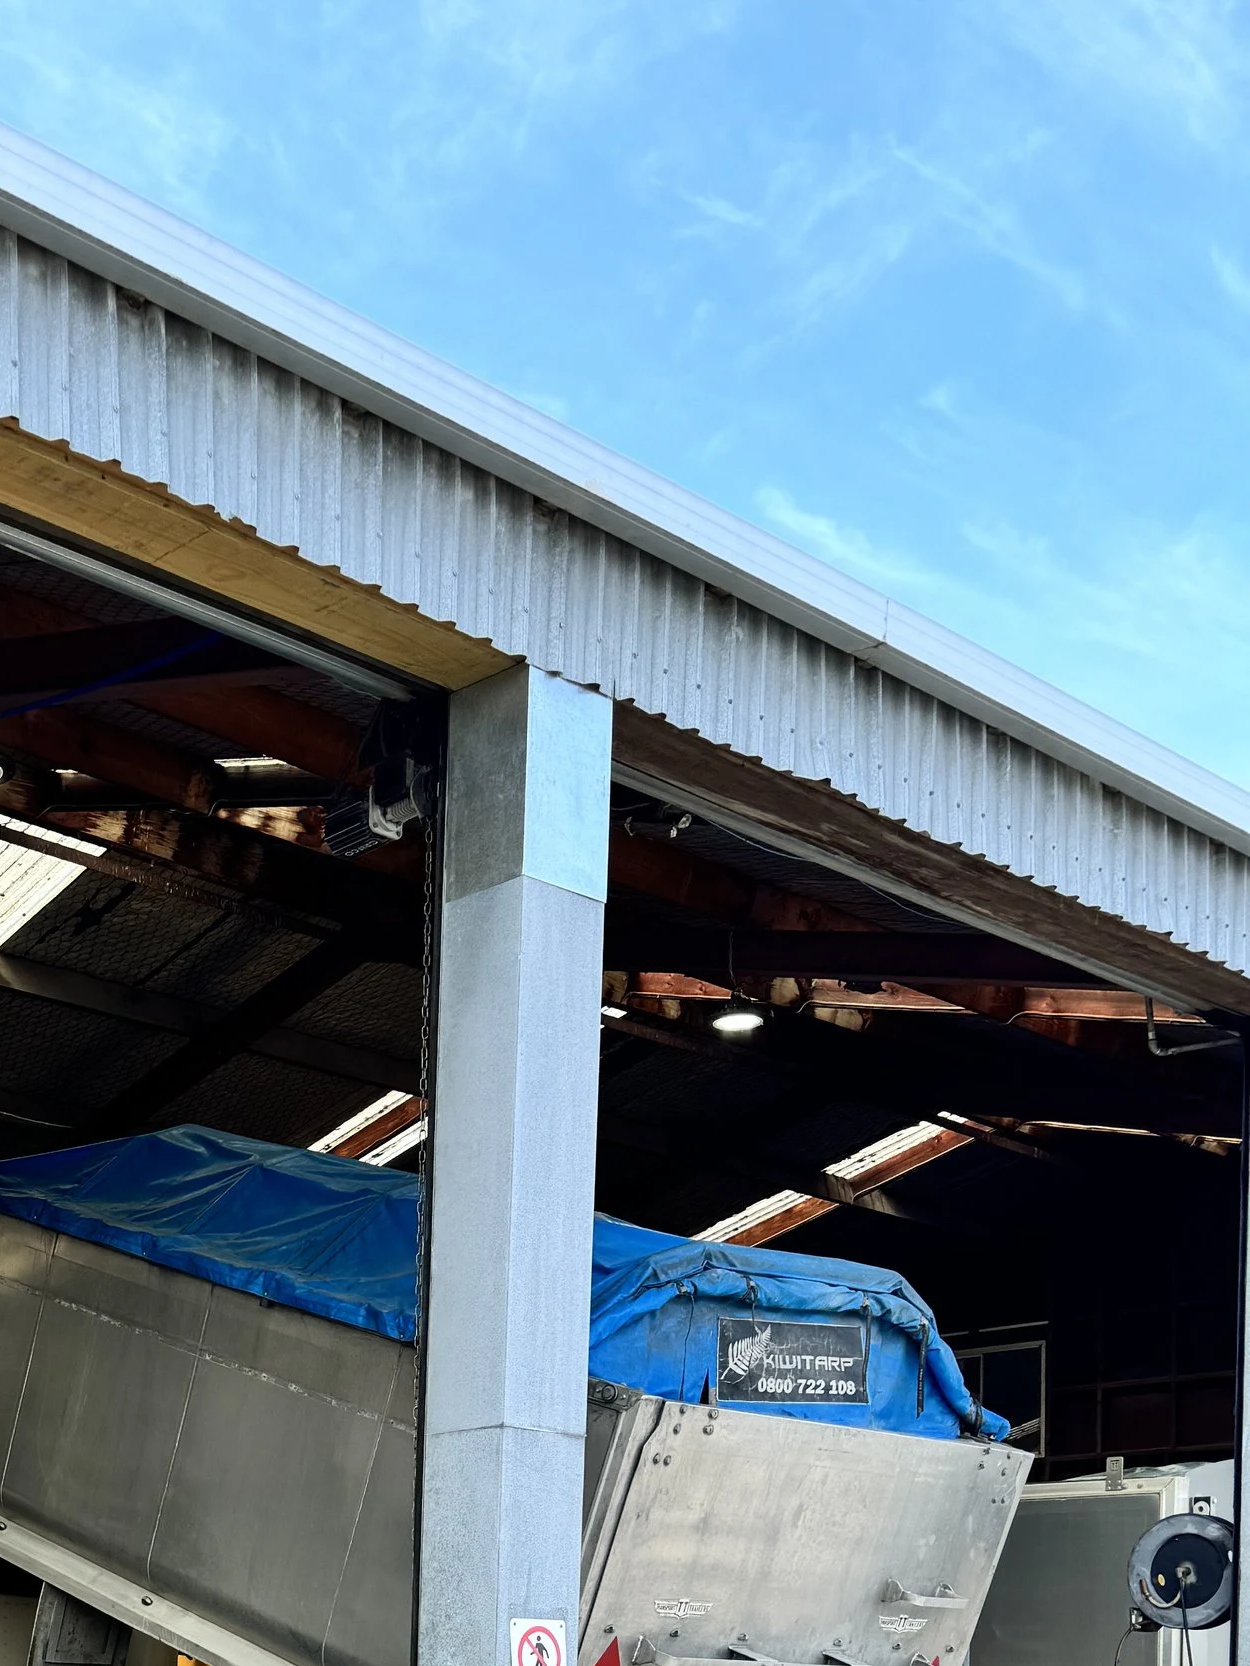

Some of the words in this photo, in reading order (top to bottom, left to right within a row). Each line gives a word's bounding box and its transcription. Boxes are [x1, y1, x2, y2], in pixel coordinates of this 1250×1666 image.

[763, 1354, 853, 1372] KIWITARP
[758, 1377, 792, 1394] 0800
[797, 1379, 826, 1395] 722
[828, 1380, 856, 1396] 108
